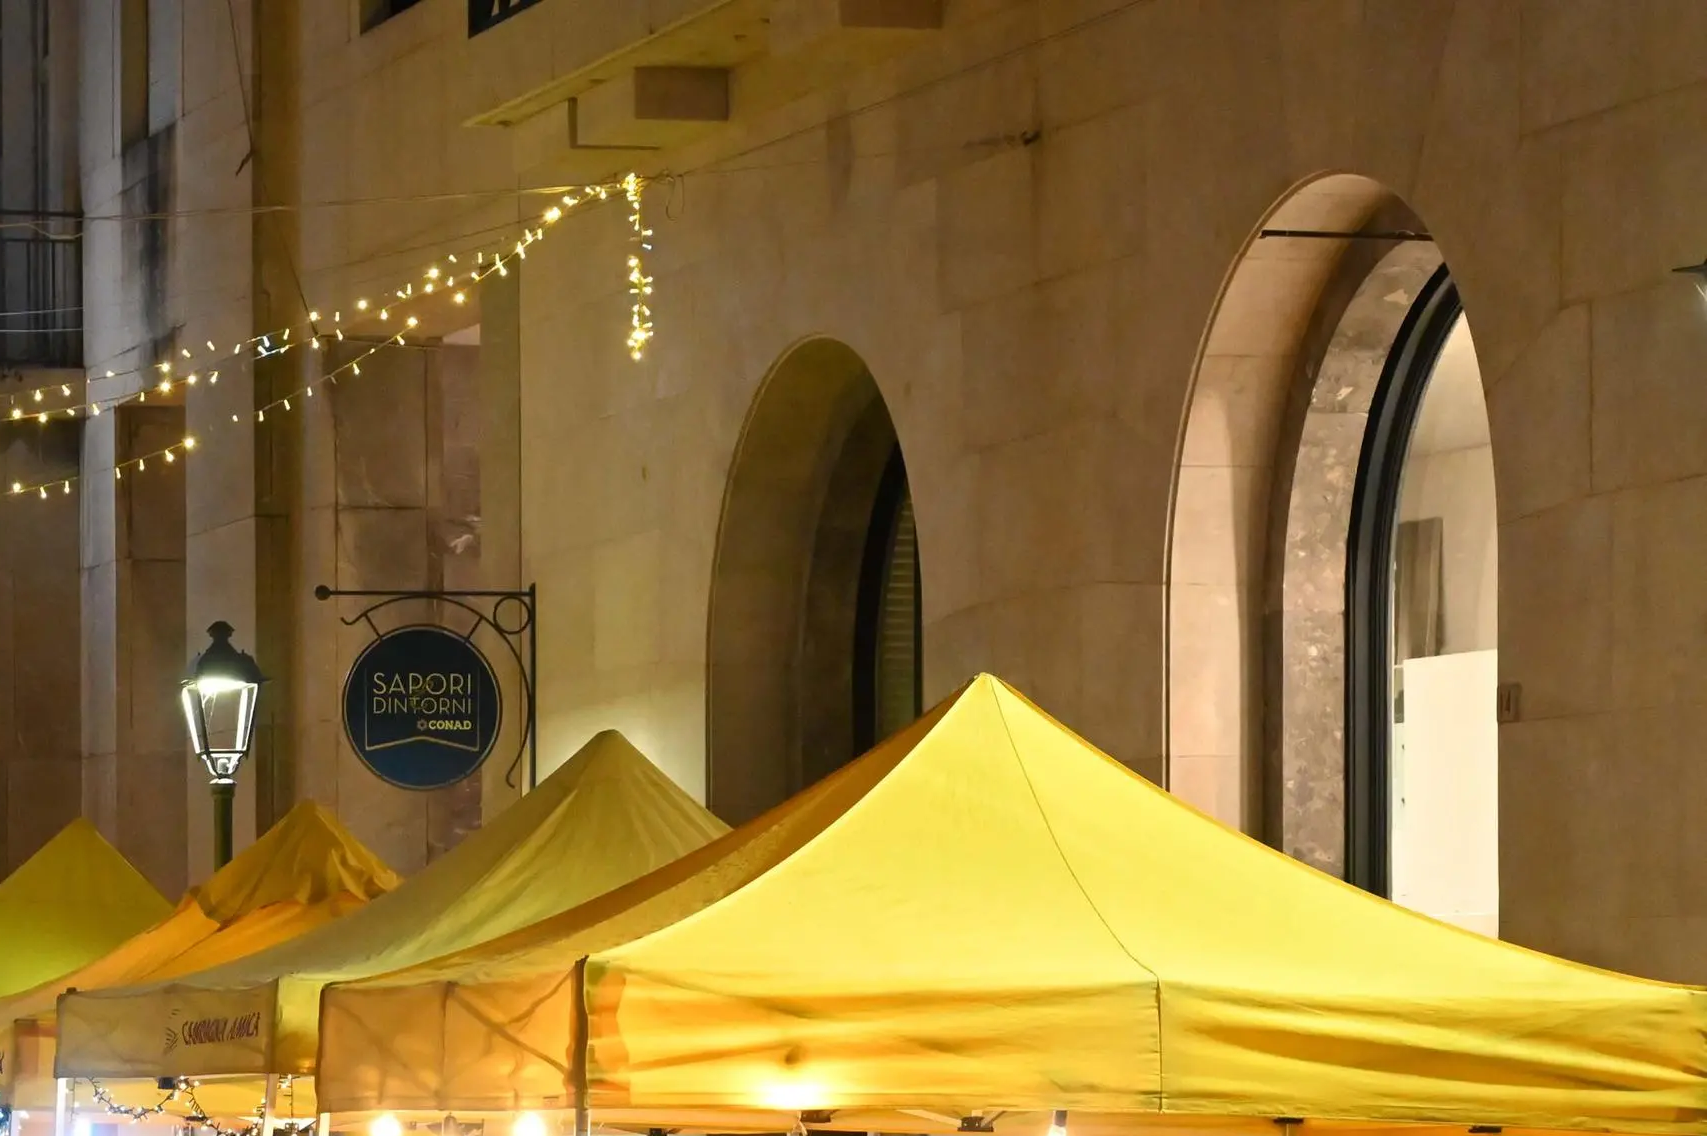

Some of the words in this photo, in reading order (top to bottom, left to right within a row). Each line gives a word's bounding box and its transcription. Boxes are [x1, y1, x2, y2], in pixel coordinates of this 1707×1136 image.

[372, 672, 472, 695] SAPORI
[372, 696, 472, 715] DINTORNI
[428, 719, 472, 731] CONAD
